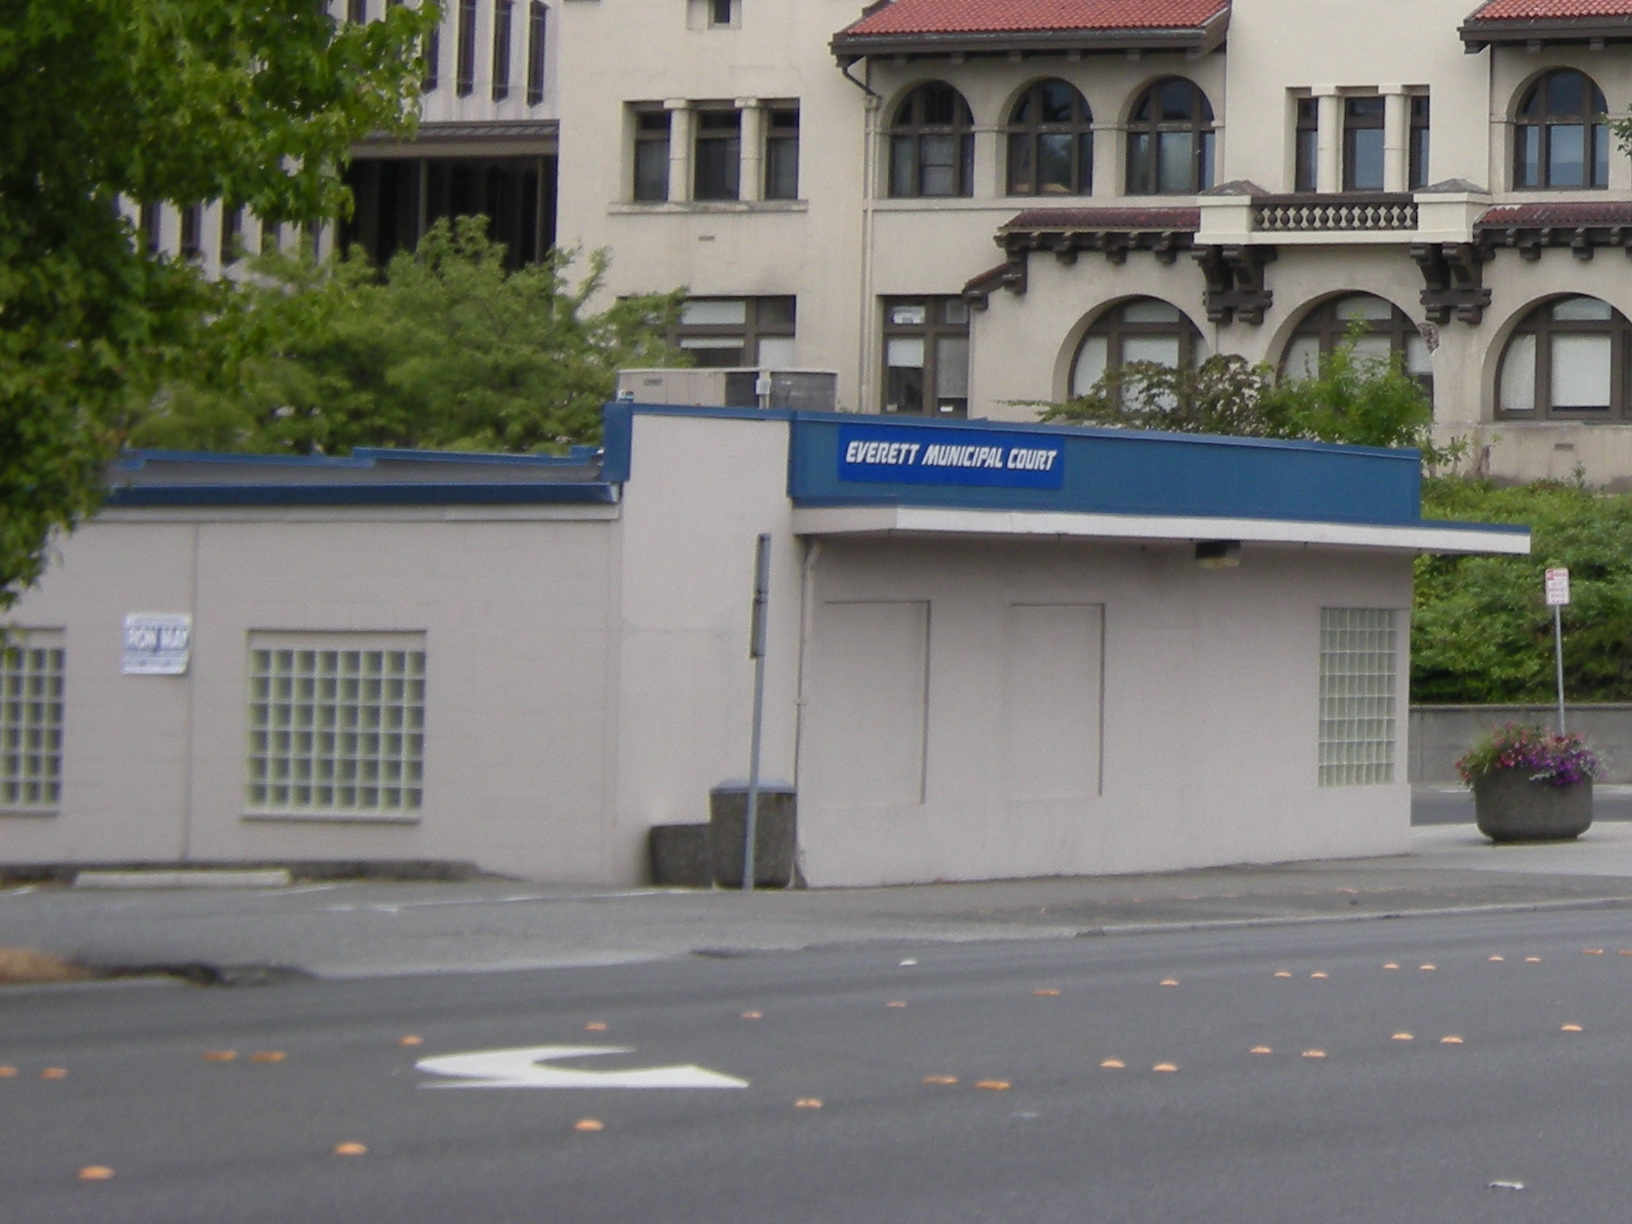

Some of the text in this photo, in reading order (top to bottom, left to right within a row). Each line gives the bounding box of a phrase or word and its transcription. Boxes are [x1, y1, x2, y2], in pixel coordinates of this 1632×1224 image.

[845, 440, 1058, 471] EVERETT MUNICIPAL COURT
